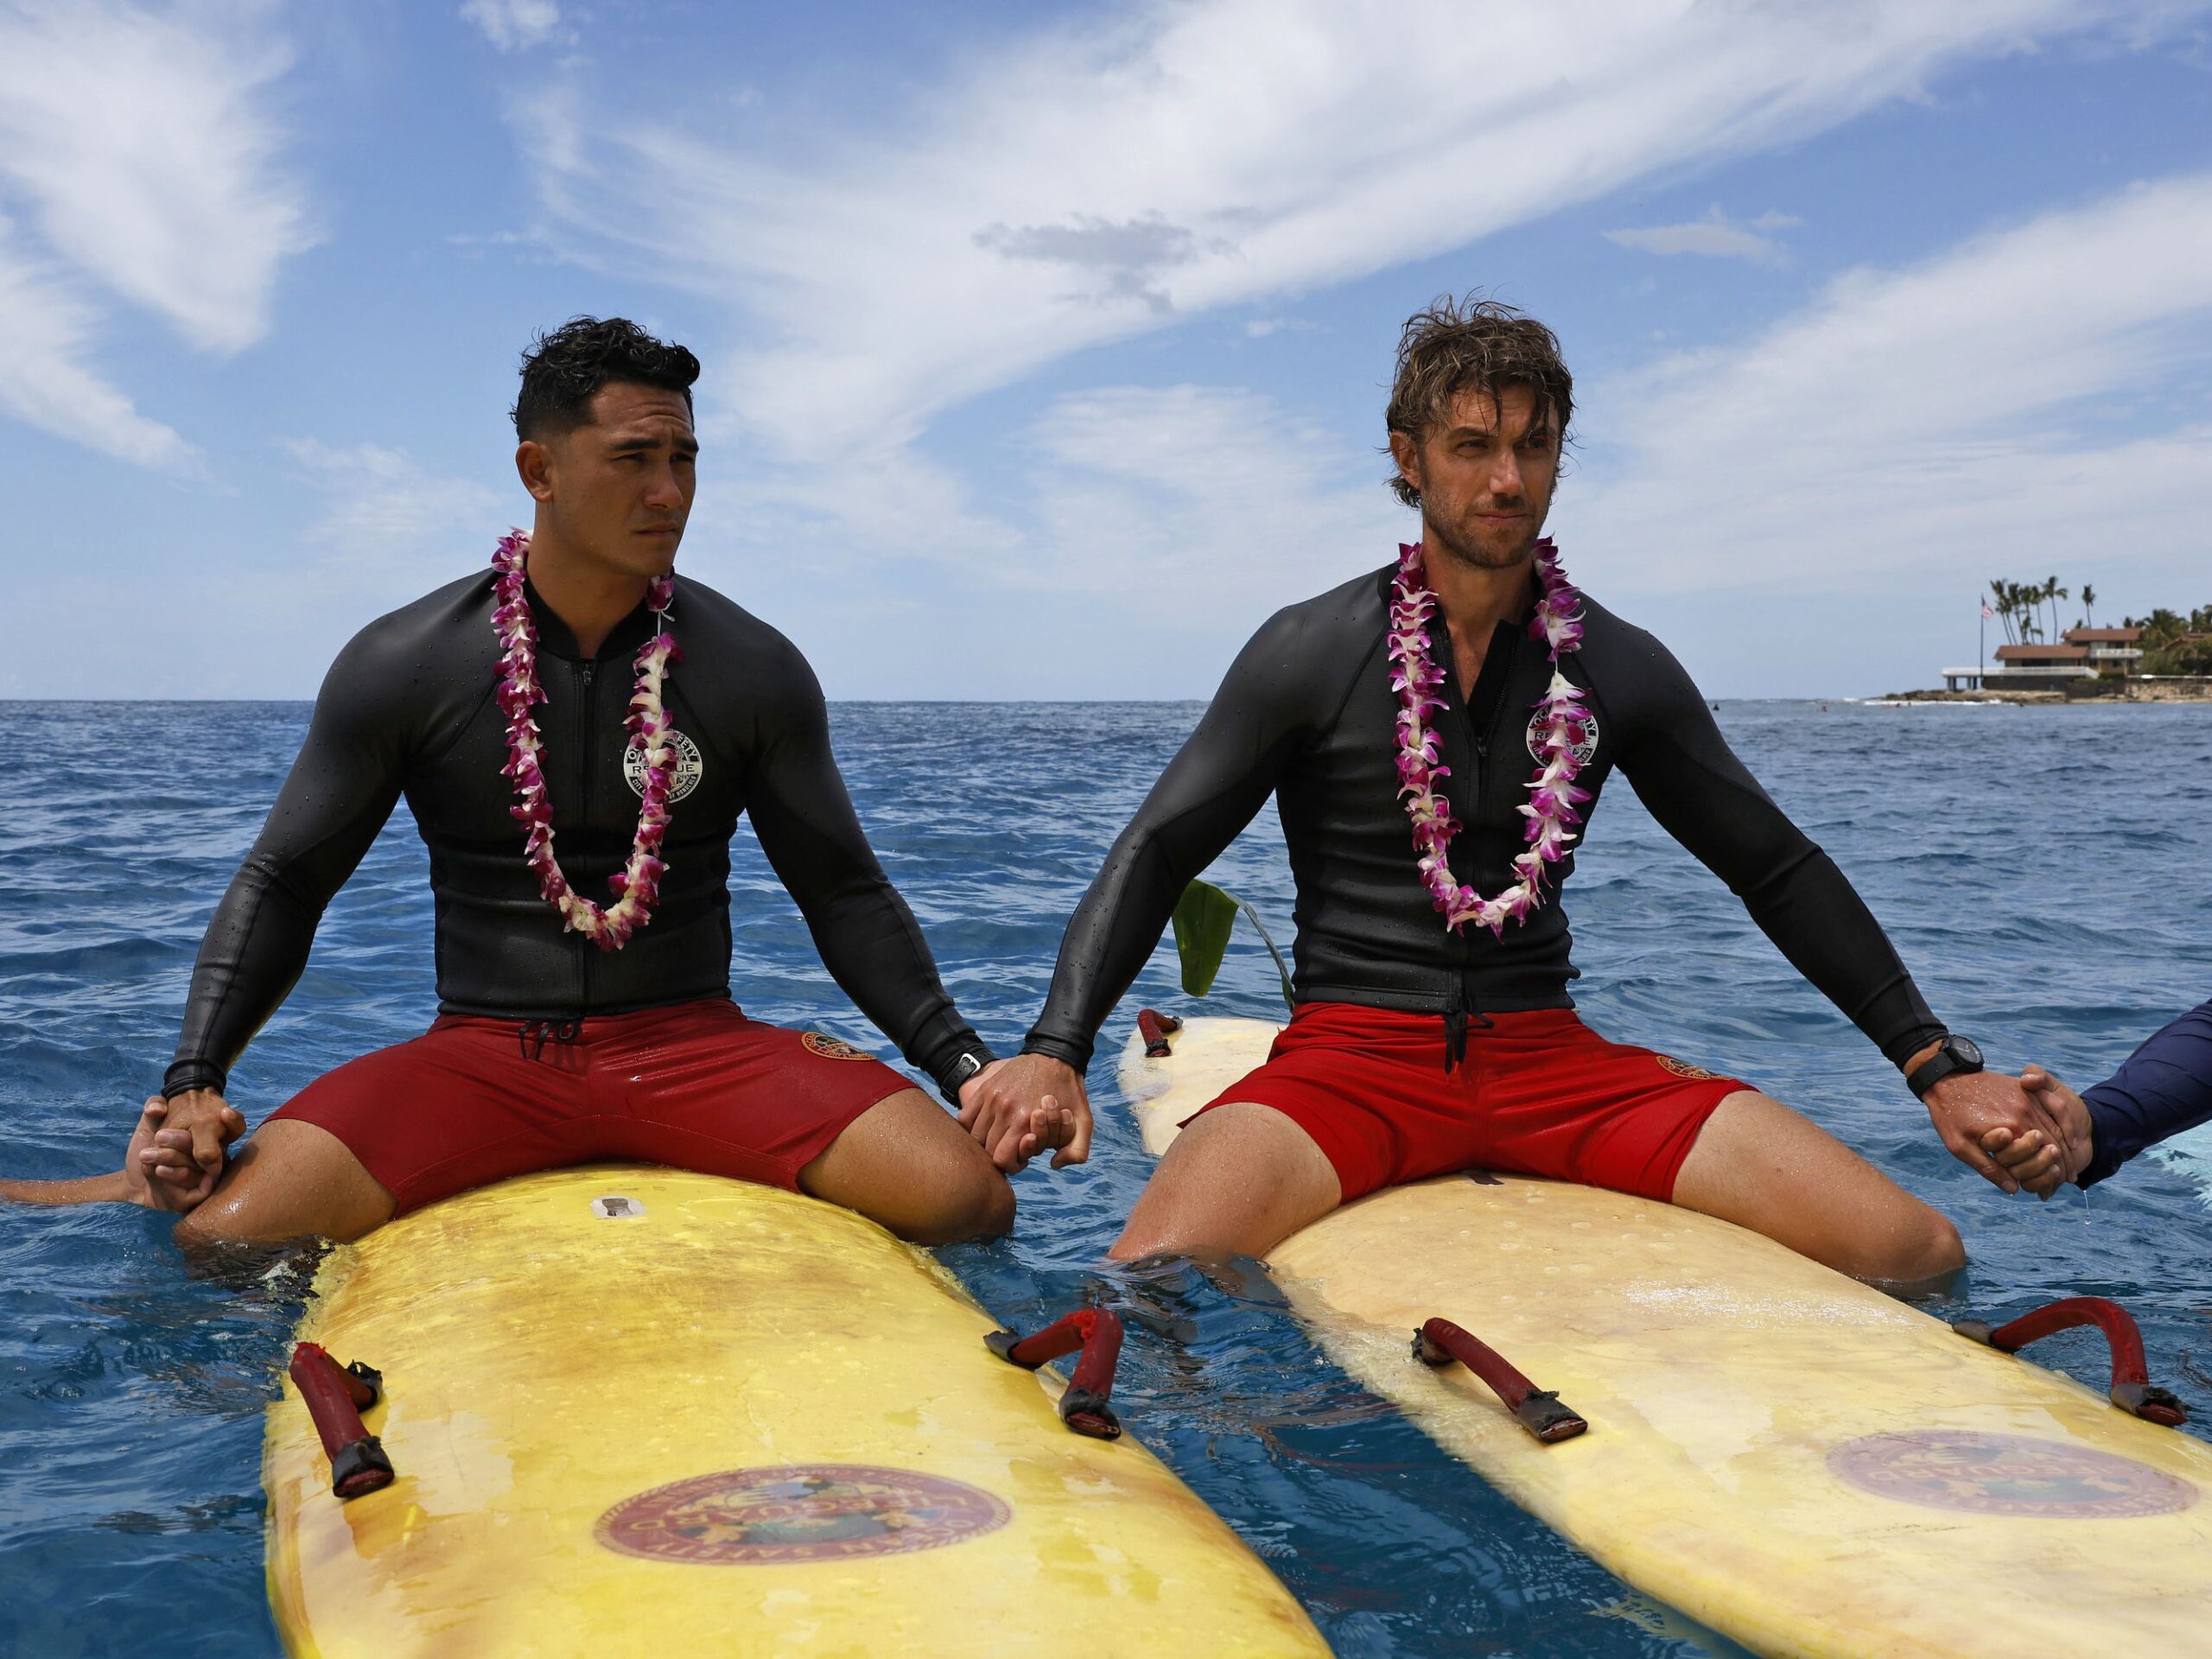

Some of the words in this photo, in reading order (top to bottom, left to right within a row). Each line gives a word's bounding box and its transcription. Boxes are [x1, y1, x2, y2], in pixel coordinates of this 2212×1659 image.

[632, 779, 643, 790] CITY
[629, 1496, 967, 1530] LIFEGUARD
[841, 1519, 976, 1553] OCEAN
[645, 1541, 813, 1558] SAFETY
